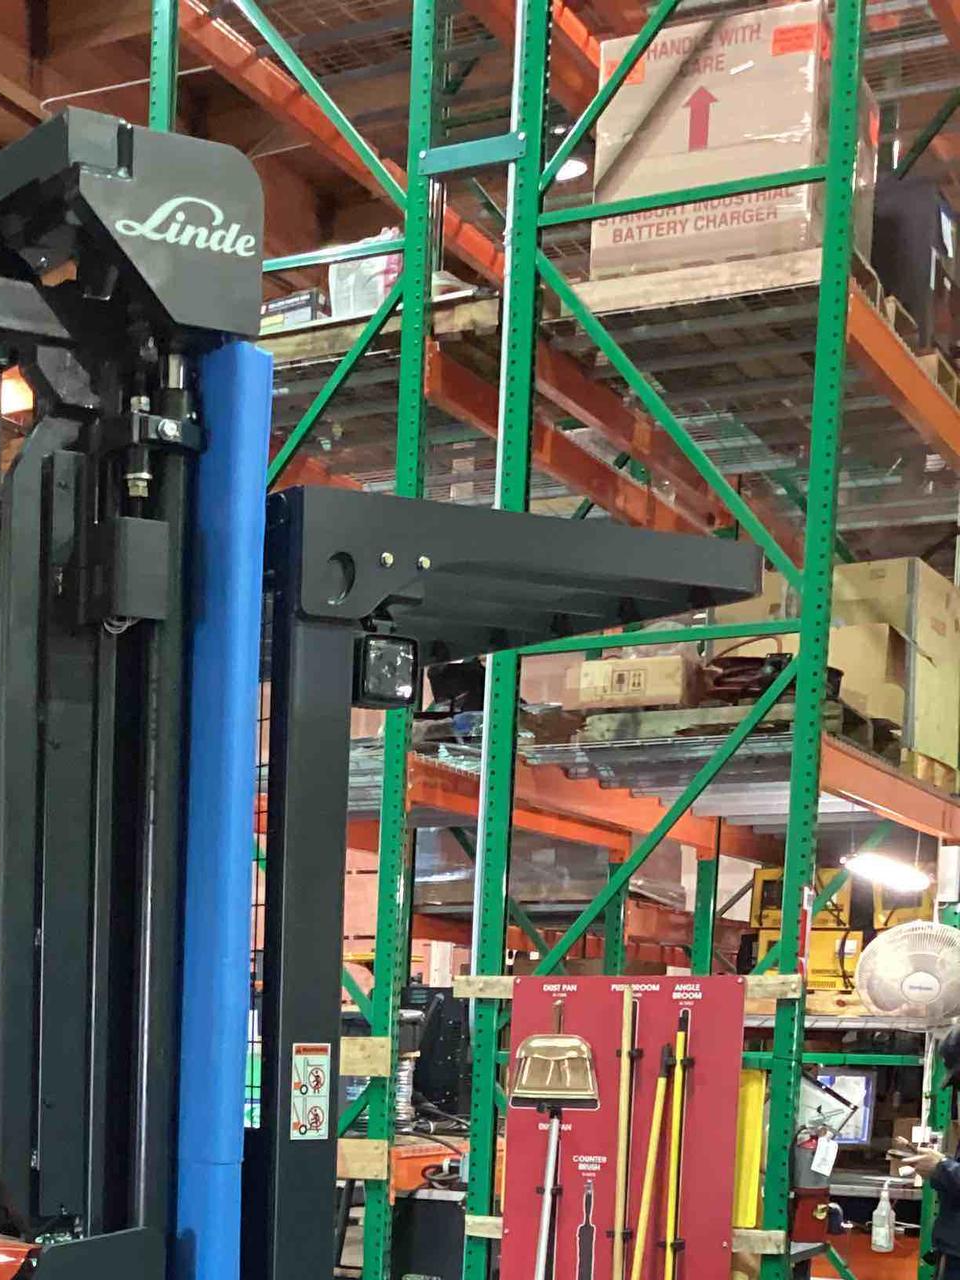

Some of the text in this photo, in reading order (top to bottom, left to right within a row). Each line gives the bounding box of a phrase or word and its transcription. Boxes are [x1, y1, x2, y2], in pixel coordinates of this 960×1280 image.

[718, 23, 761, 46] WITH
[684, 54, 726, 76] ARE
[114, 196, 256, 257] Linde
[612, 206, 778, 244] BATTERY CHARGER
[675, 983, 701, 991] ANGLE
[572, 1155, 607, 1163] COUNTER
